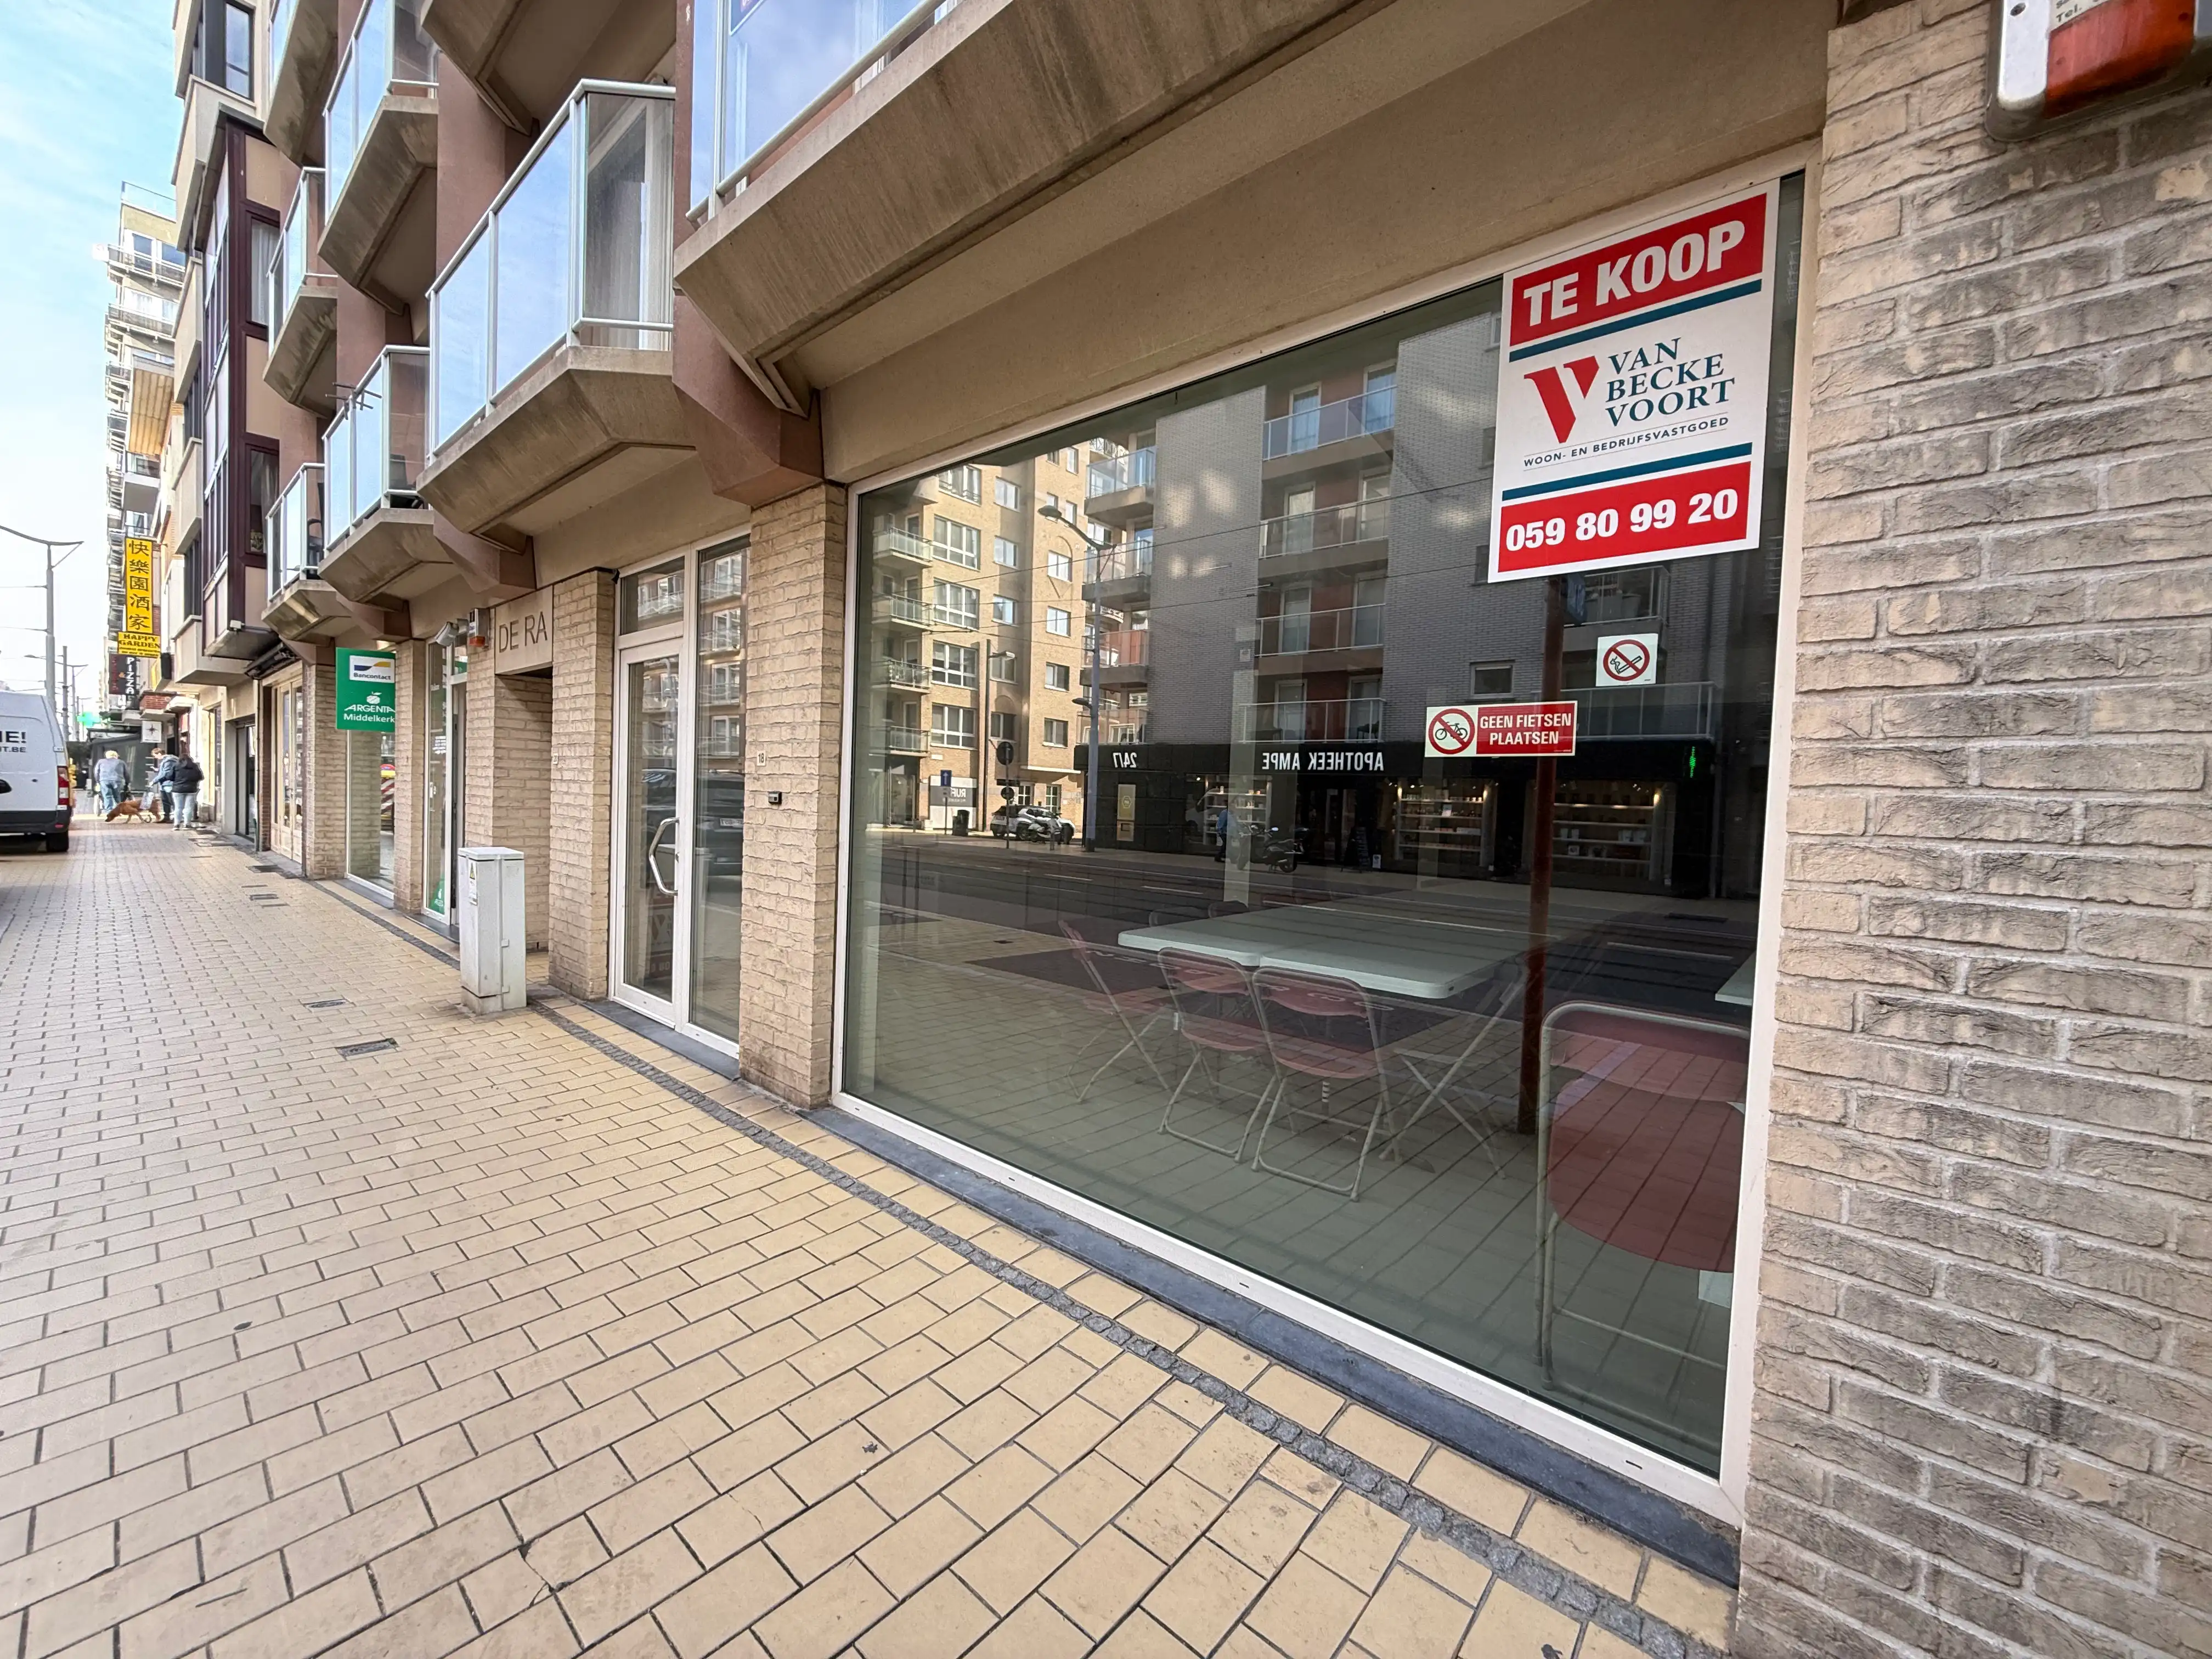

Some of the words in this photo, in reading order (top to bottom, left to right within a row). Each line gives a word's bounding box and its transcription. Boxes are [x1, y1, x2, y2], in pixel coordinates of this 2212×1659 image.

[2056, 4, 2082, 22] Tel.
[1523, 272, 1578, 326] TE
[1596, 221, 1745, 306] KOOP
[1607, 337, 1681, 375] VAN
[1606, 353, 1725, 402] BECKE
[1606, 377, 1736, 427] VOORT
[1524, 452, 1566, 467] WOON-
[1571, 447, 1587, 457] EN
[1593, 417, 1729, 452] BEDRIJFSVASTGOED
[1506, 517, 1566, 551] 059
[1576, 509, 1618, 540] 80
[1630, 498, 1677, 532] 99
[1688, 488, 1738, 524] 20
[117, 640, 160, 648] GARDEN
[123, 634, 157, 642] HAPPY
[499, 620, 519, 653] DE
[126, 657, 135, 694] PIZZA
[344, 704, 396, 713] ARGENTA
[343, 714, 395, 723] Middelkerk
[1480, 715, 1513, 729] GEEN
[1516, 713, 1571, 727] FIETSEN
[0, 731, 26, 743] E!
[1489, 731, 1559, 745] PLAATSEN
[758, 753, 764, 763] 18
